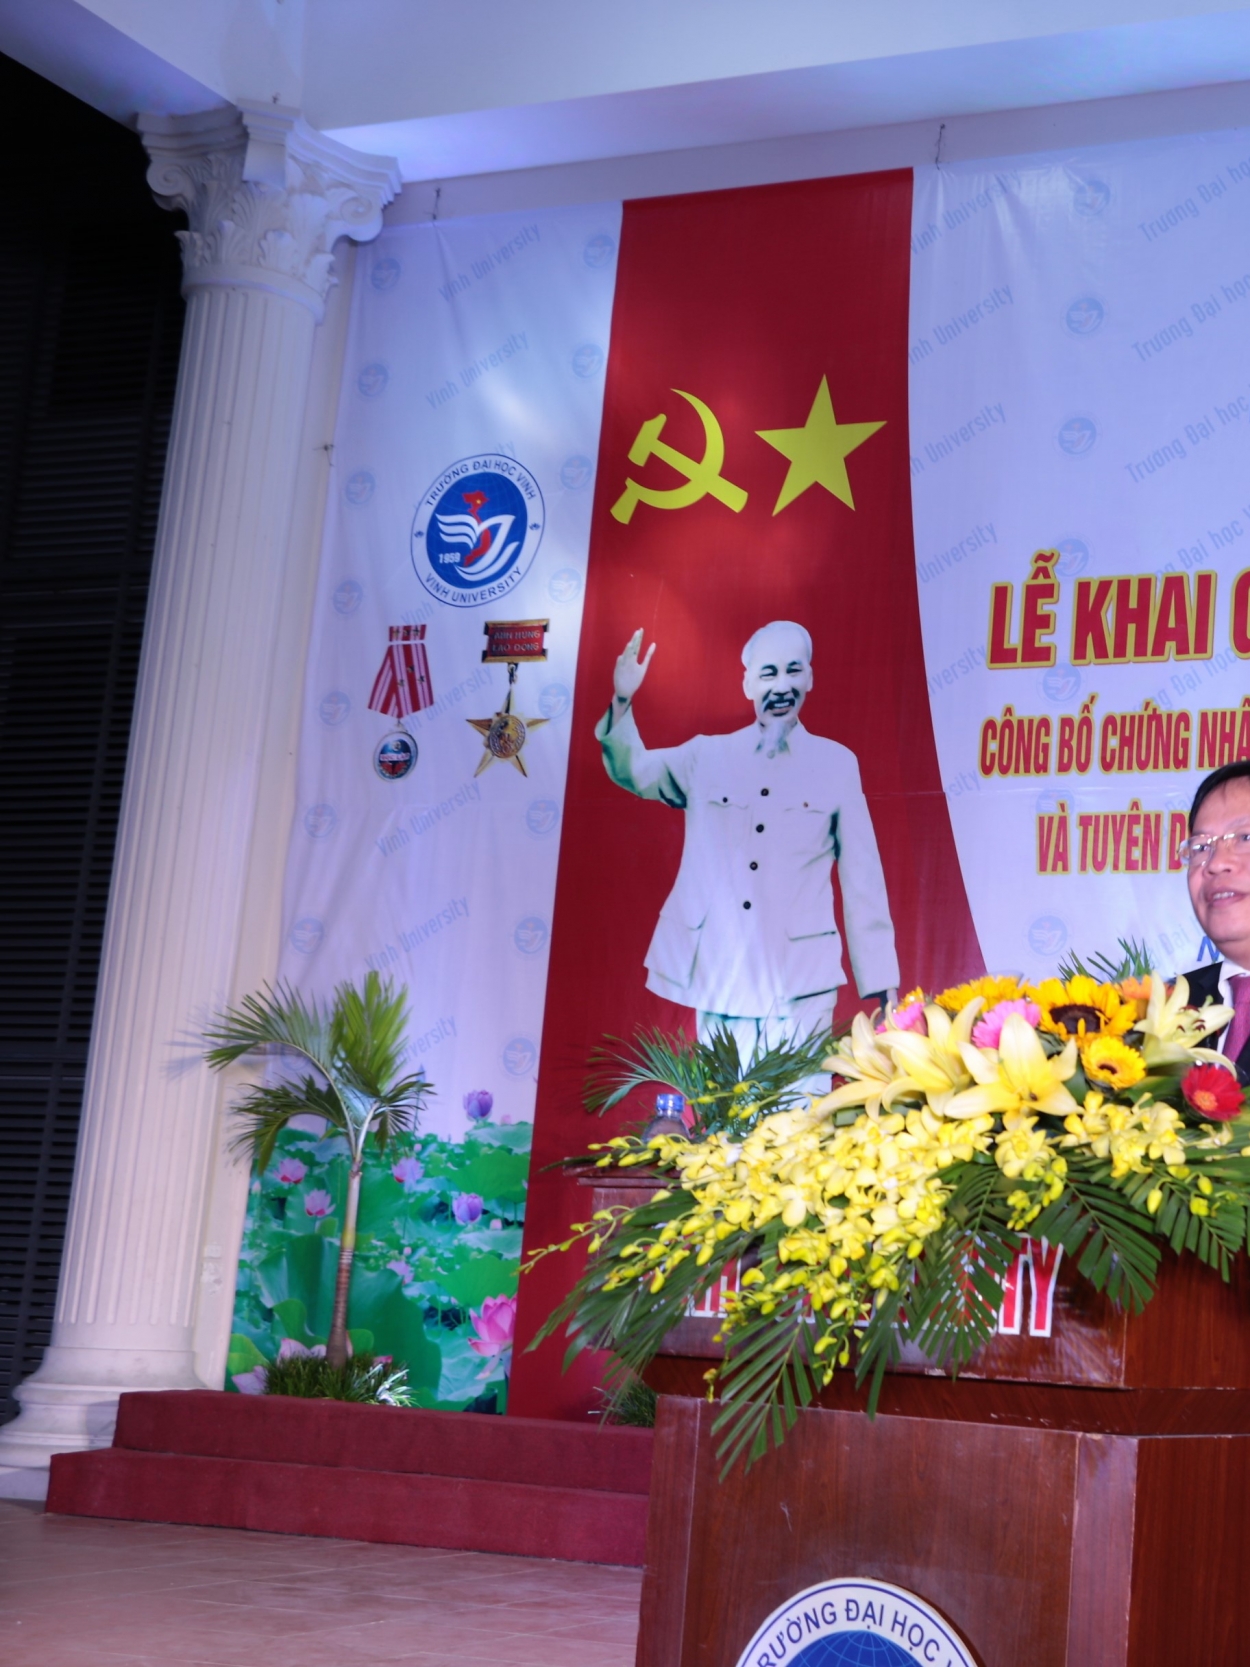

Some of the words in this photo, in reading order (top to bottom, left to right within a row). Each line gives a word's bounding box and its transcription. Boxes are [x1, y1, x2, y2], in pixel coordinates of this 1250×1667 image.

[438, 272, 471, 302] Vinh
[425, 377, 458, 409] Vinh
[517, 472, 536, 501] VINH
[425, 573, 450, 599] VINH
[451, 565, 522, 604] UNIVERSITY
[989, 552, 1056, 665] LỄ
[1072, 573, 1213, 662] KHAI
[980, 706, 1052, 777] CÔNG
[1056, 693, 1094, 774] BỐ
[1100, 700, 1192, 773] CHỨNG
[375, 826, 410, 857] Vinh
[1038, 803, 1070, 873] VÀ
[1078, 800, 1162, 873] TUYÊN
[756, 1600, 838, 1667] RƯỜNG
[844, 1598, 885, 1630] ĐẠI
[890, 1609, 941, 1664] HỌC
